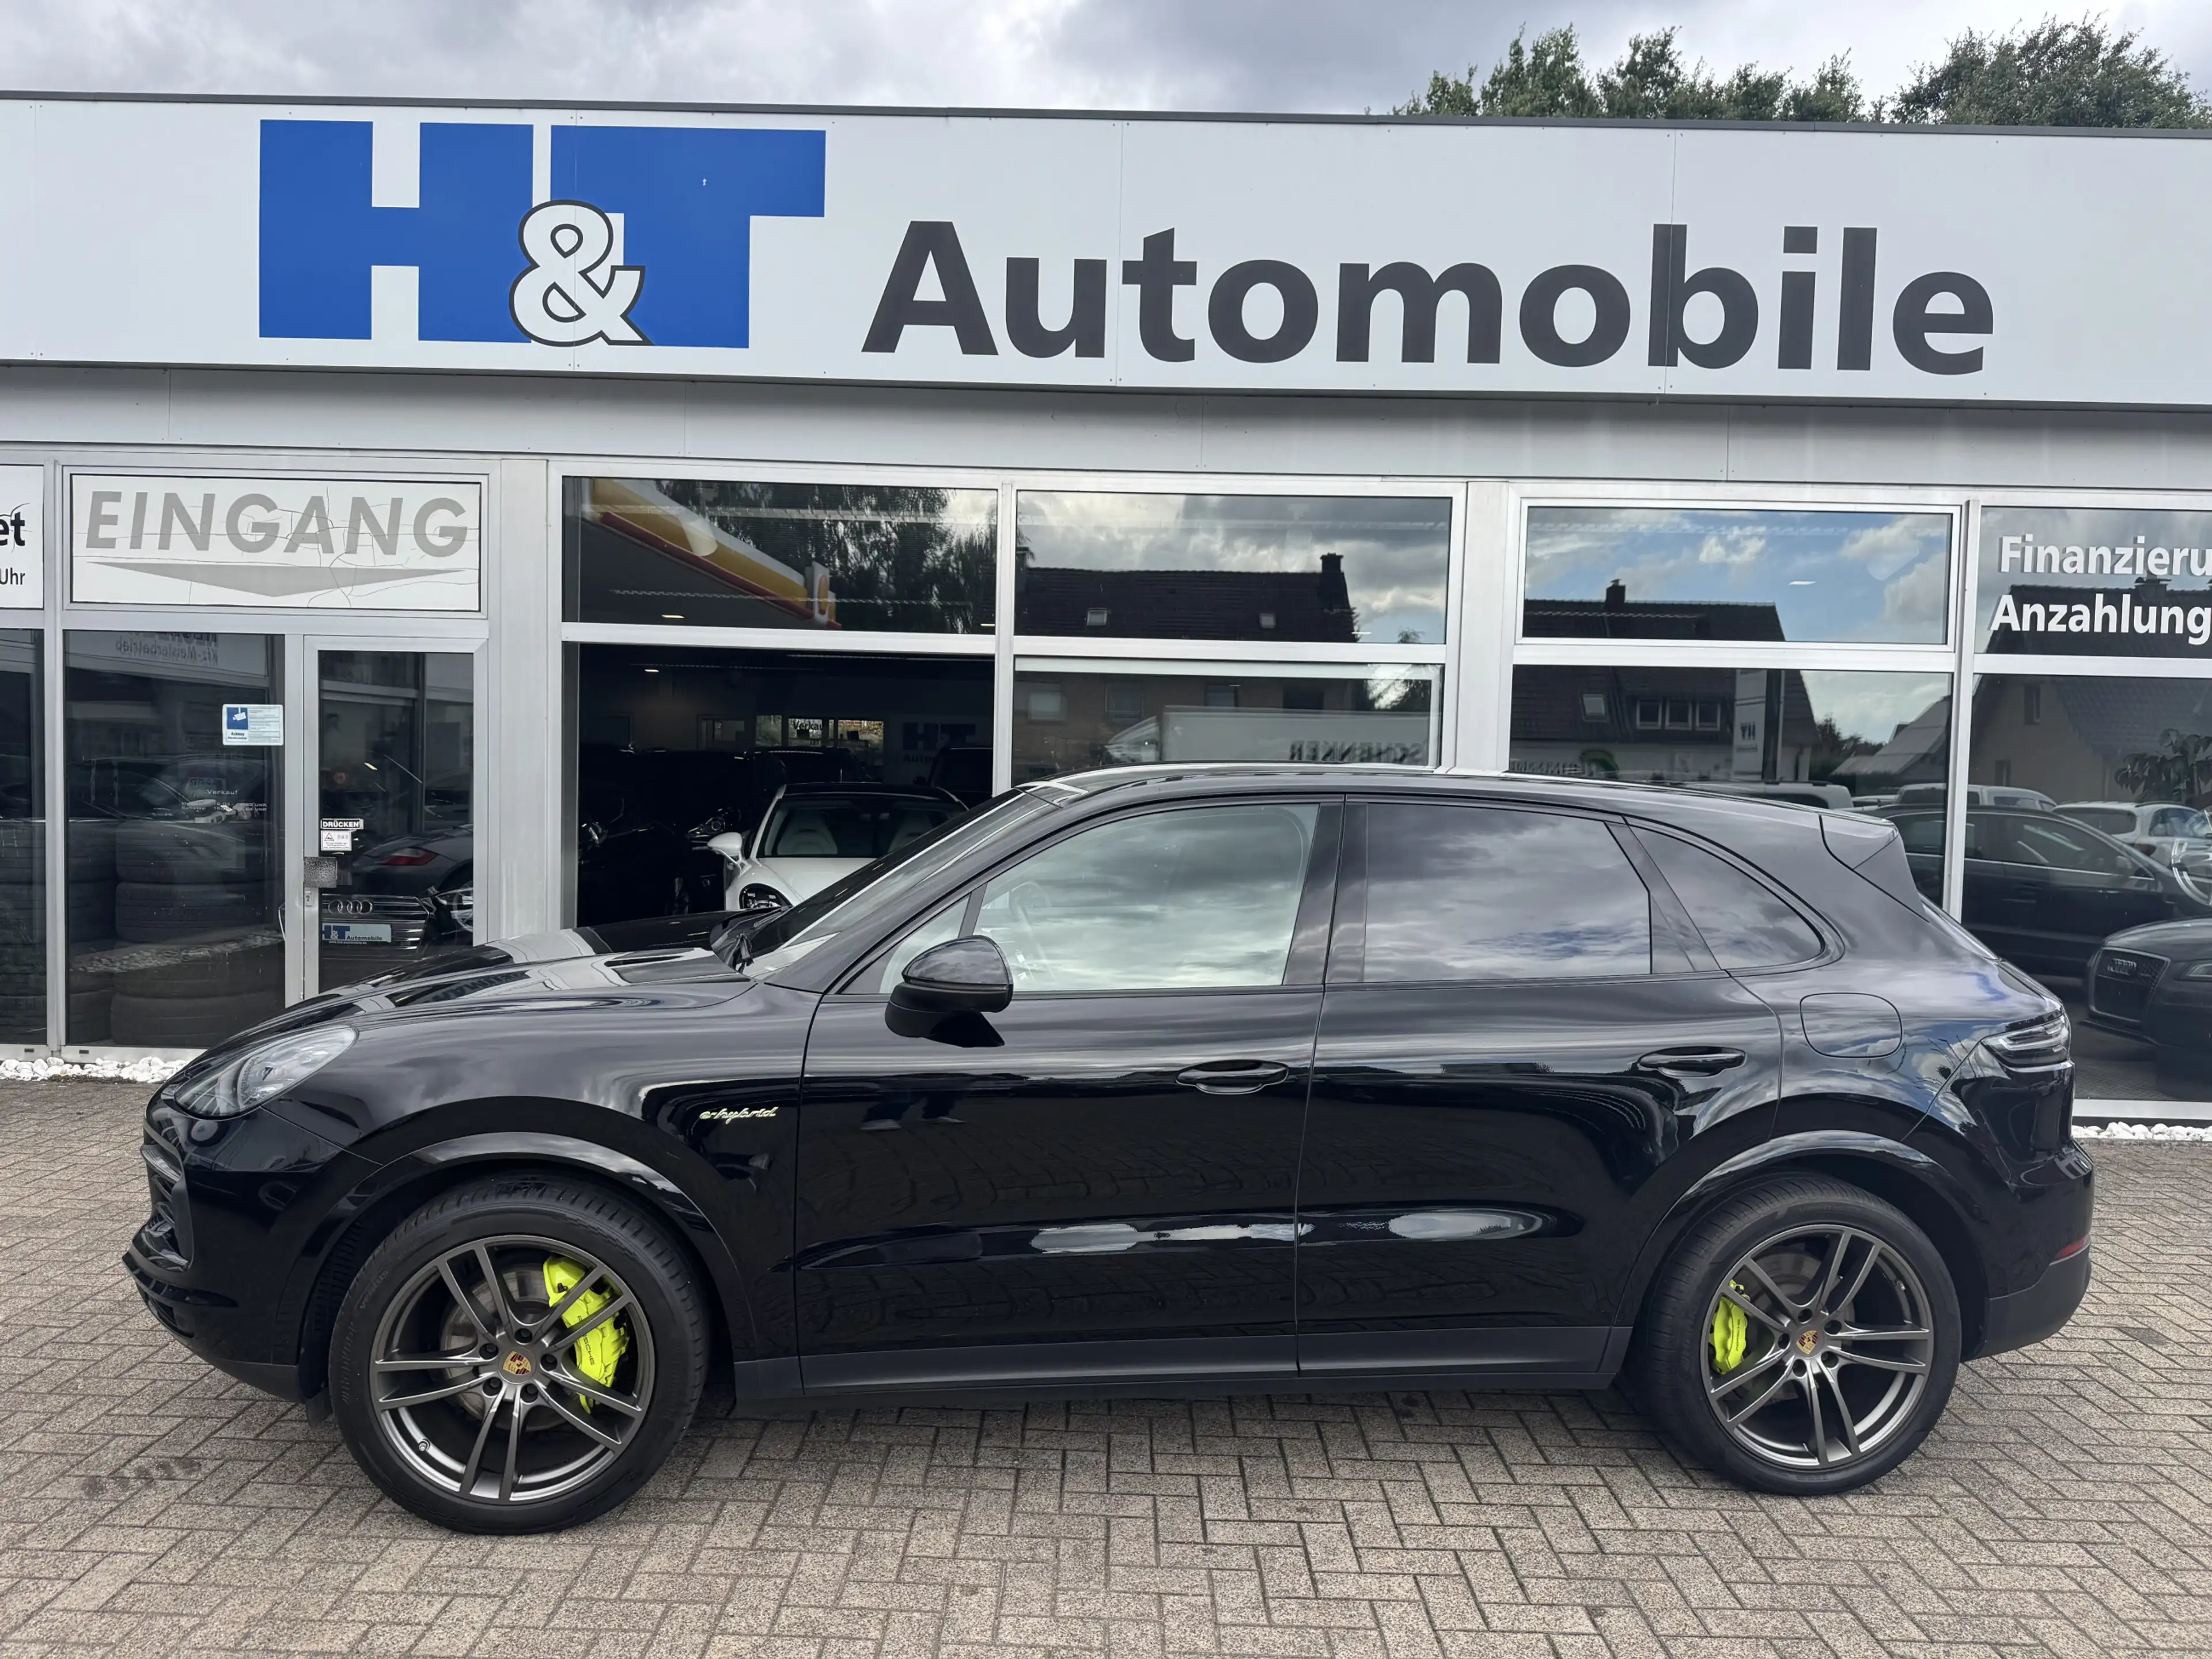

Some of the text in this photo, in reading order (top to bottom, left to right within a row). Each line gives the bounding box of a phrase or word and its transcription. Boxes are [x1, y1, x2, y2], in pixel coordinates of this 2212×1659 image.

[259, 119, 1994, 374] H&T Automobile
[86, 491, 467, 557] EINGANG
[0, 567, 25, 585] Uhr
[2001, 533, 2212, 576] Finanzieru
[1990, 593, 2212, 645] Anzahlung
[577, 1315, 595, 1366] PSCHE
